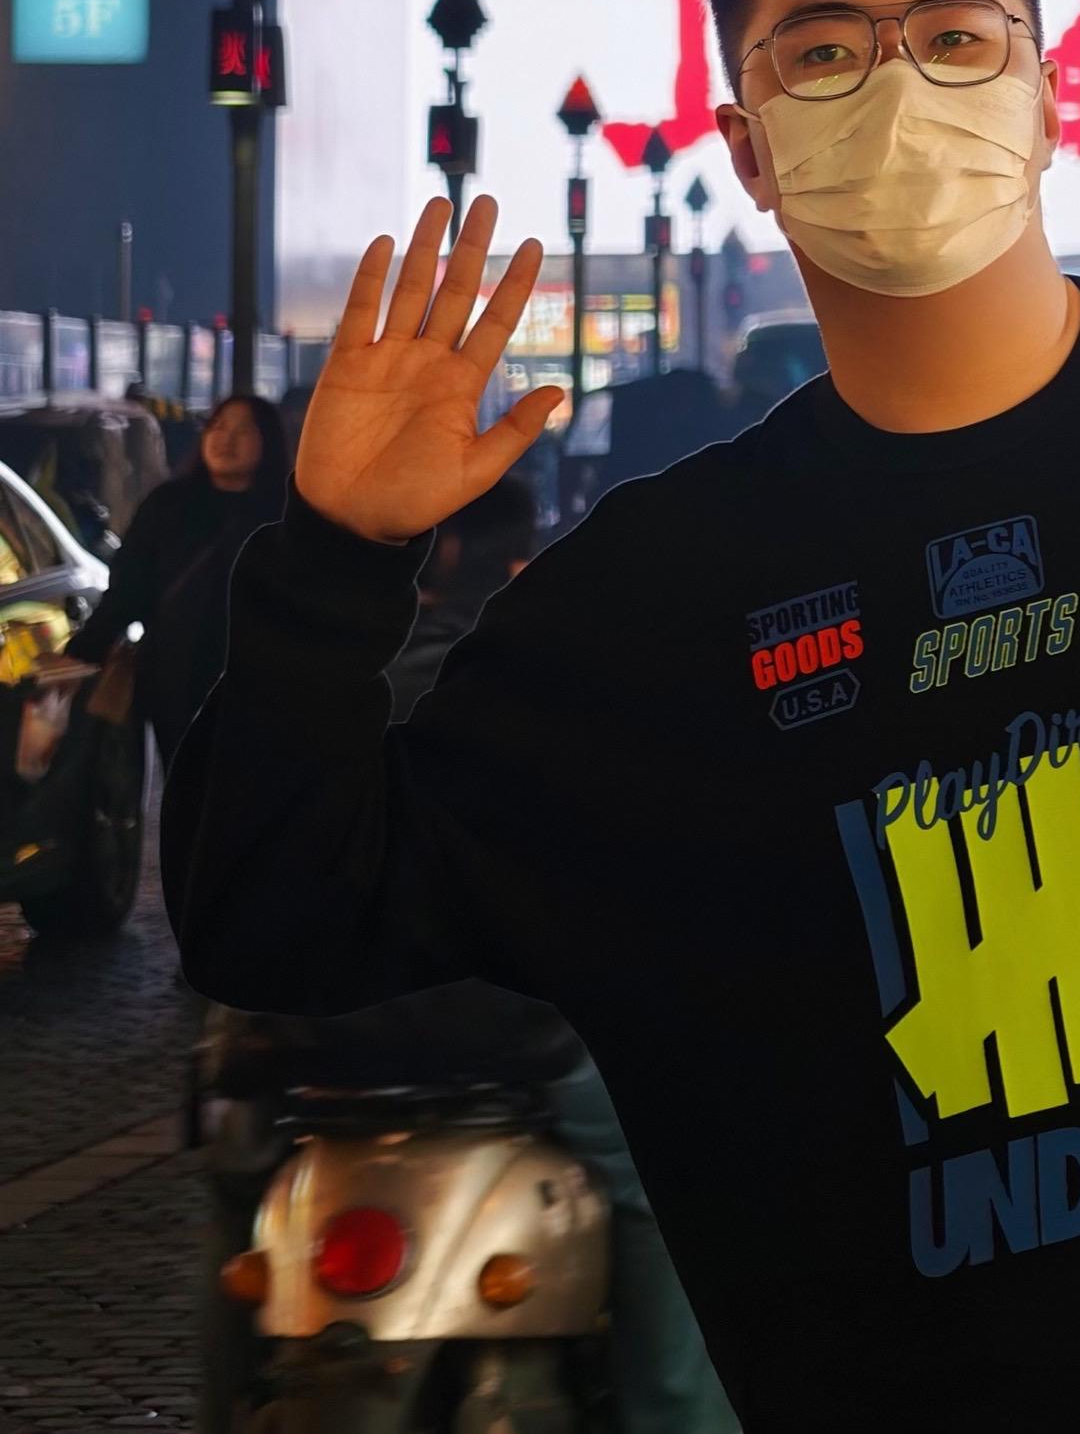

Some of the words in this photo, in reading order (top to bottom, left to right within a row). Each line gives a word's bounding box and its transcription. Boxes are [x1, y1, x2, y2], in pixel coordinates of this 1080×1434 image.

[746, 584, 859, 646] SPORTING
[949, 569, 1027, 598] ATHLETICS
[752, 618, 864, 690] GOODS
[909, 591, 1080, 694] SPORTS
